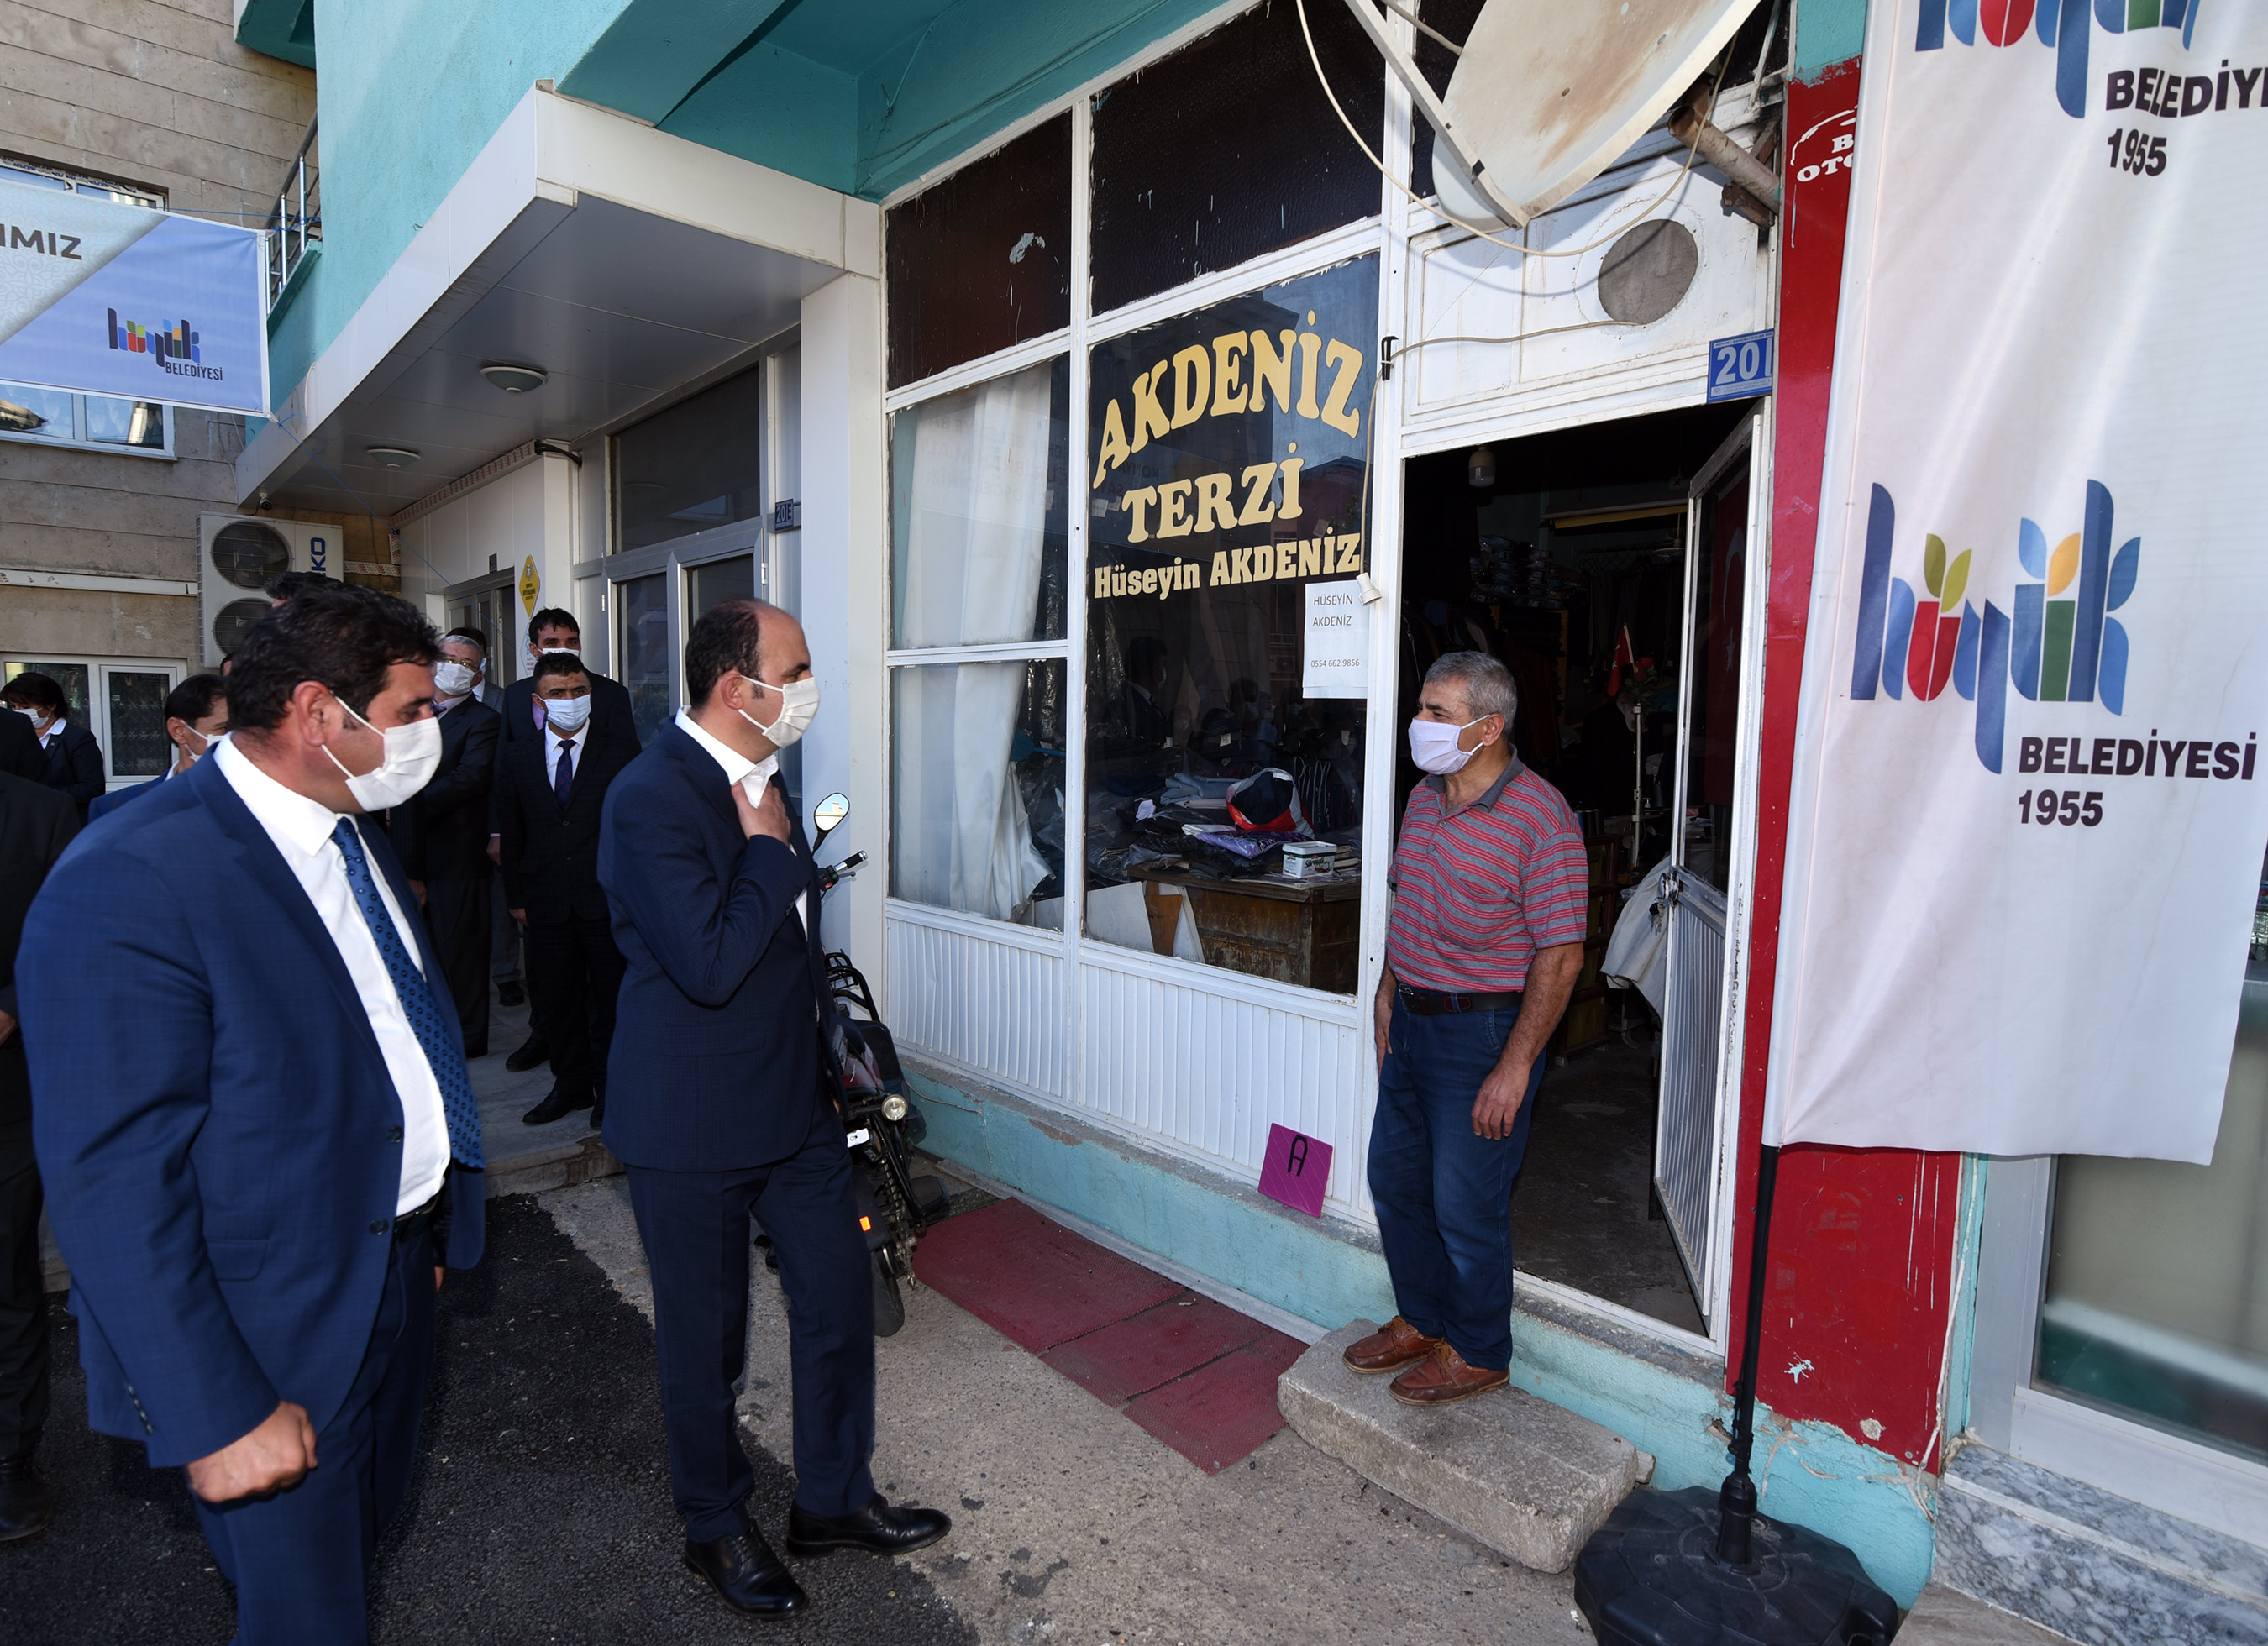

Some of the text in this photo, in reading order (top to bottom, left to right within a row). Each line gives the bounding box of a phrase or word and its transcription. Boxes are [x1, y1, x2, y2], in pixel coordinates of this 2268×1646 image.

[2106, 60, 2268, 118] BELEDİY
[2108, 128, 2167, 176] 1955
[165, 362, 223, 380] BELEDİYESİ
[1716, 343, 1760, 385] 20
[1093, 310, 1364, 490] AKDENİZ
[1122, 443, 1305, 543] TERZİ
[1095, 527, 1361, 600] Hüseyin AKDENİZ
[1312, 614, 1352, 626] AKDENİZ
[1314, 593, 1353, 606] HÜSEYİN
[1342, 658, 1360, 667] 9856
[2019, 729, 2257, 781] BELEDİYESİ
[2018, 789, 2103, 826] 1955
